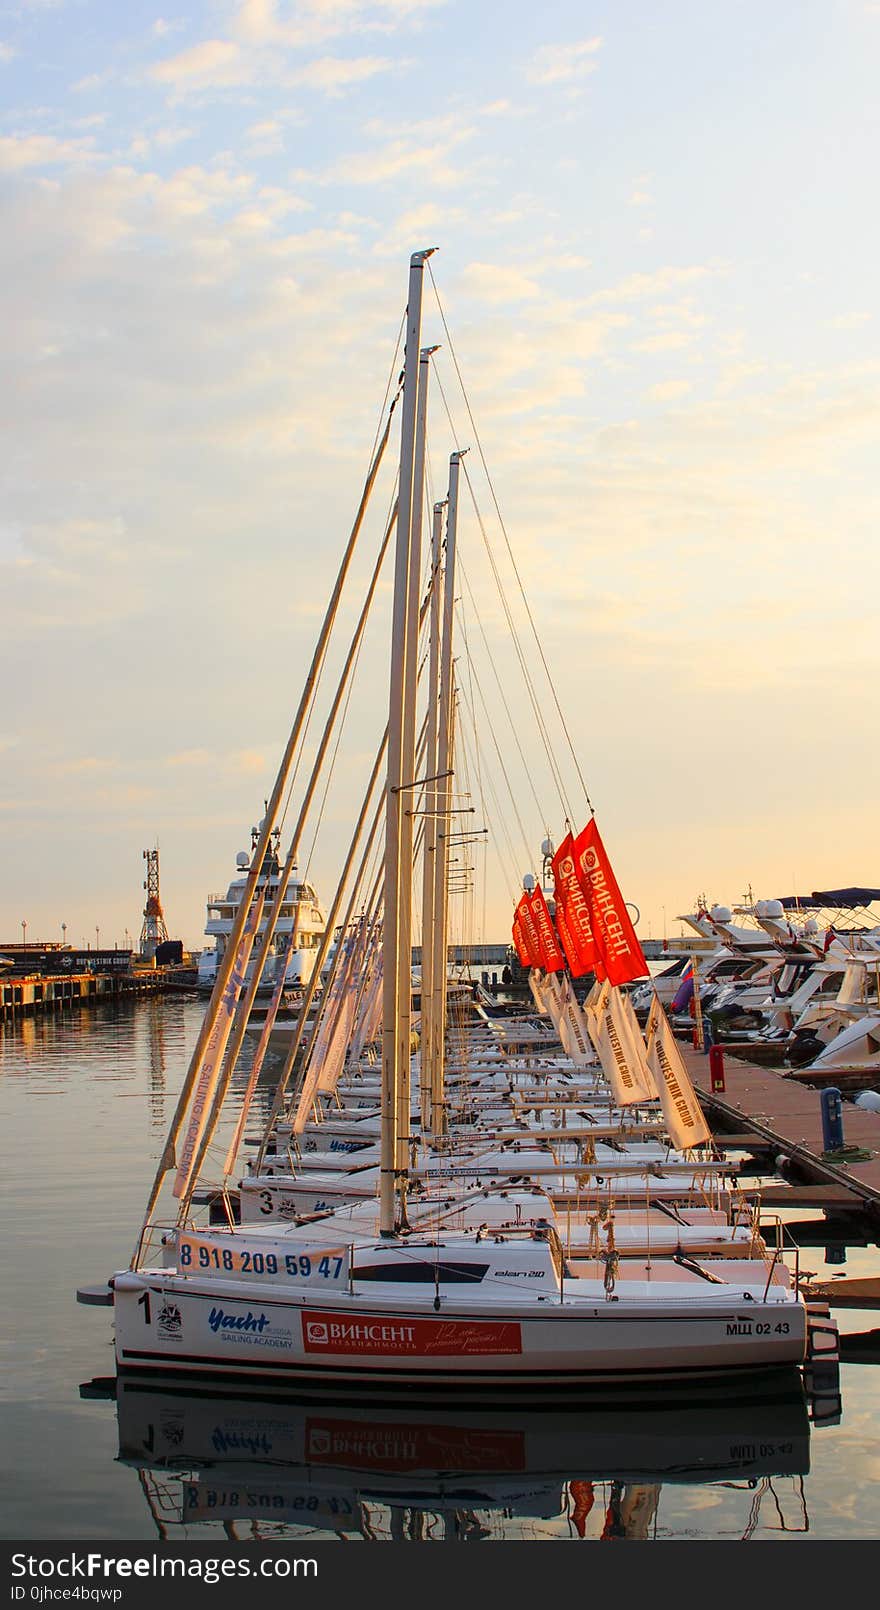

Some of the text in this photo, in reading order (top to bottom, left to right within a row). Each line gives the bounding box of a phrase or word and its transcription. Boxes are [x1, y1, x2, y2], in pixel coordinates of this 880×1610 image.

[590, 870, 632, 956] ВИНСЕНТ
[605, 1015, 634, 1089] BUREVESTNIK GROUP
[655, 1040, 695, 1129] BUREVESTNIK GROUP
[179, 1063, 213, 1180] SAILING ACADEMY
[259, 1190, 274, 1214] 3
[180, 1243, 343, 1279] 8 918 209 59 47
[138, 1291, 151, 1325] 1
[220, 1332, 293, 1349] SAILING ACADEMY
[330, 1322, 416, 1342] ВИНСЕНТ
[726, 1322, 790, 1335] МШ 02 43
